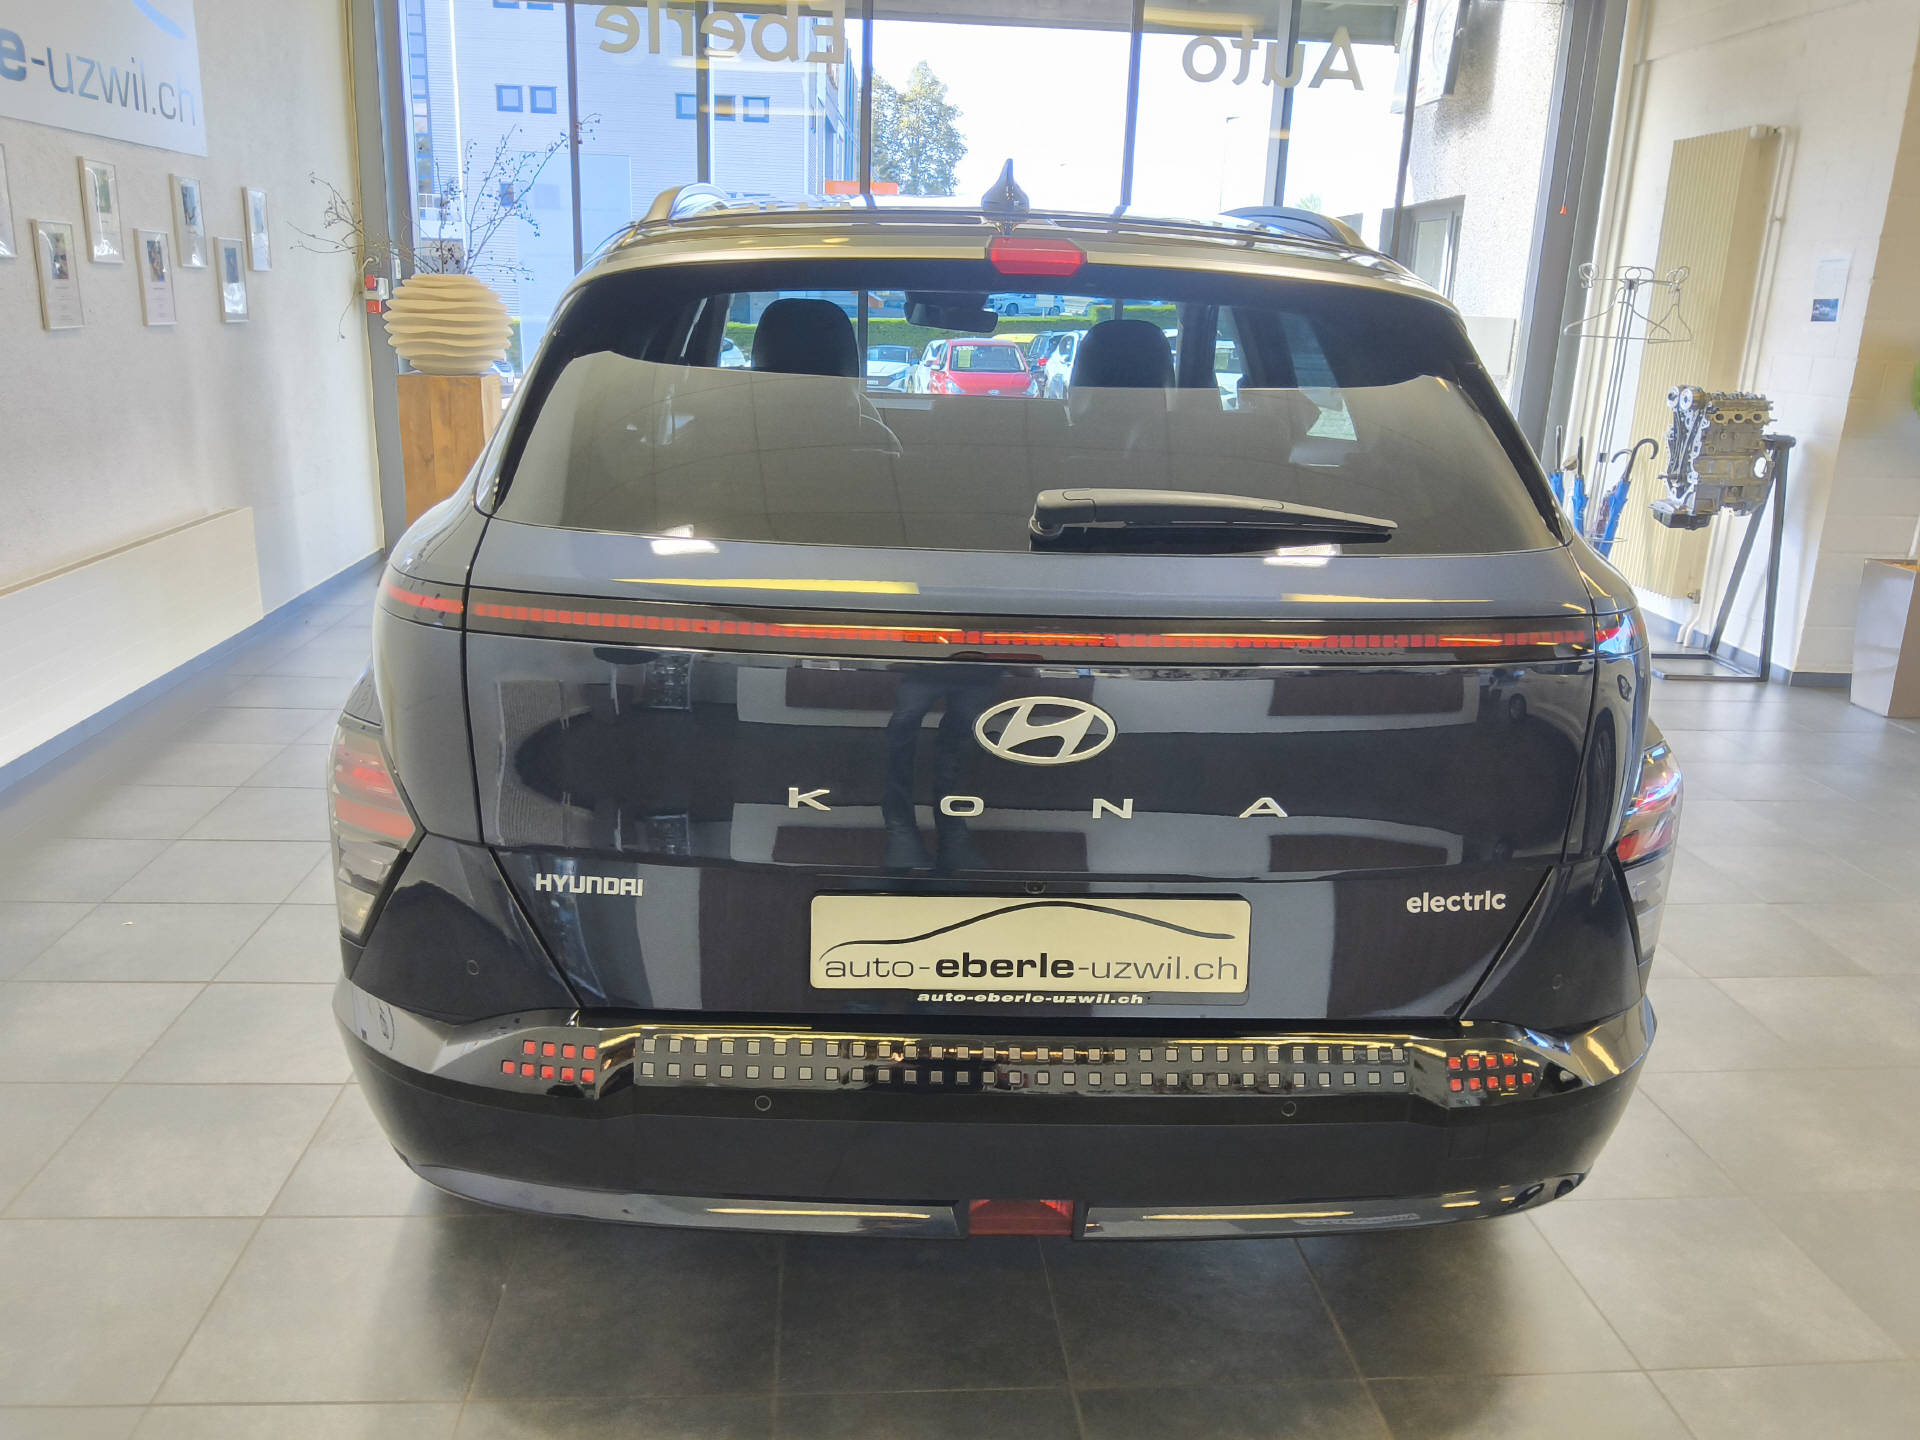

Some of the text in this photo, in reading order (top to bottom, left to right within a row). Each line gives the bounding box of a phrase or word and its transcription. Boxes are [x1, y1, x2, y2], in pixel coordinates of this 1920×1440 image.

[535, 872, 644, 897] HYUNDAI
[1406, 890, 1506, 914] electric
[825, 952, 1238, 980] auto-eberle-uzwil.ch
[917, 991, 1144, 1004] auto-eberle-uzwil.ch
